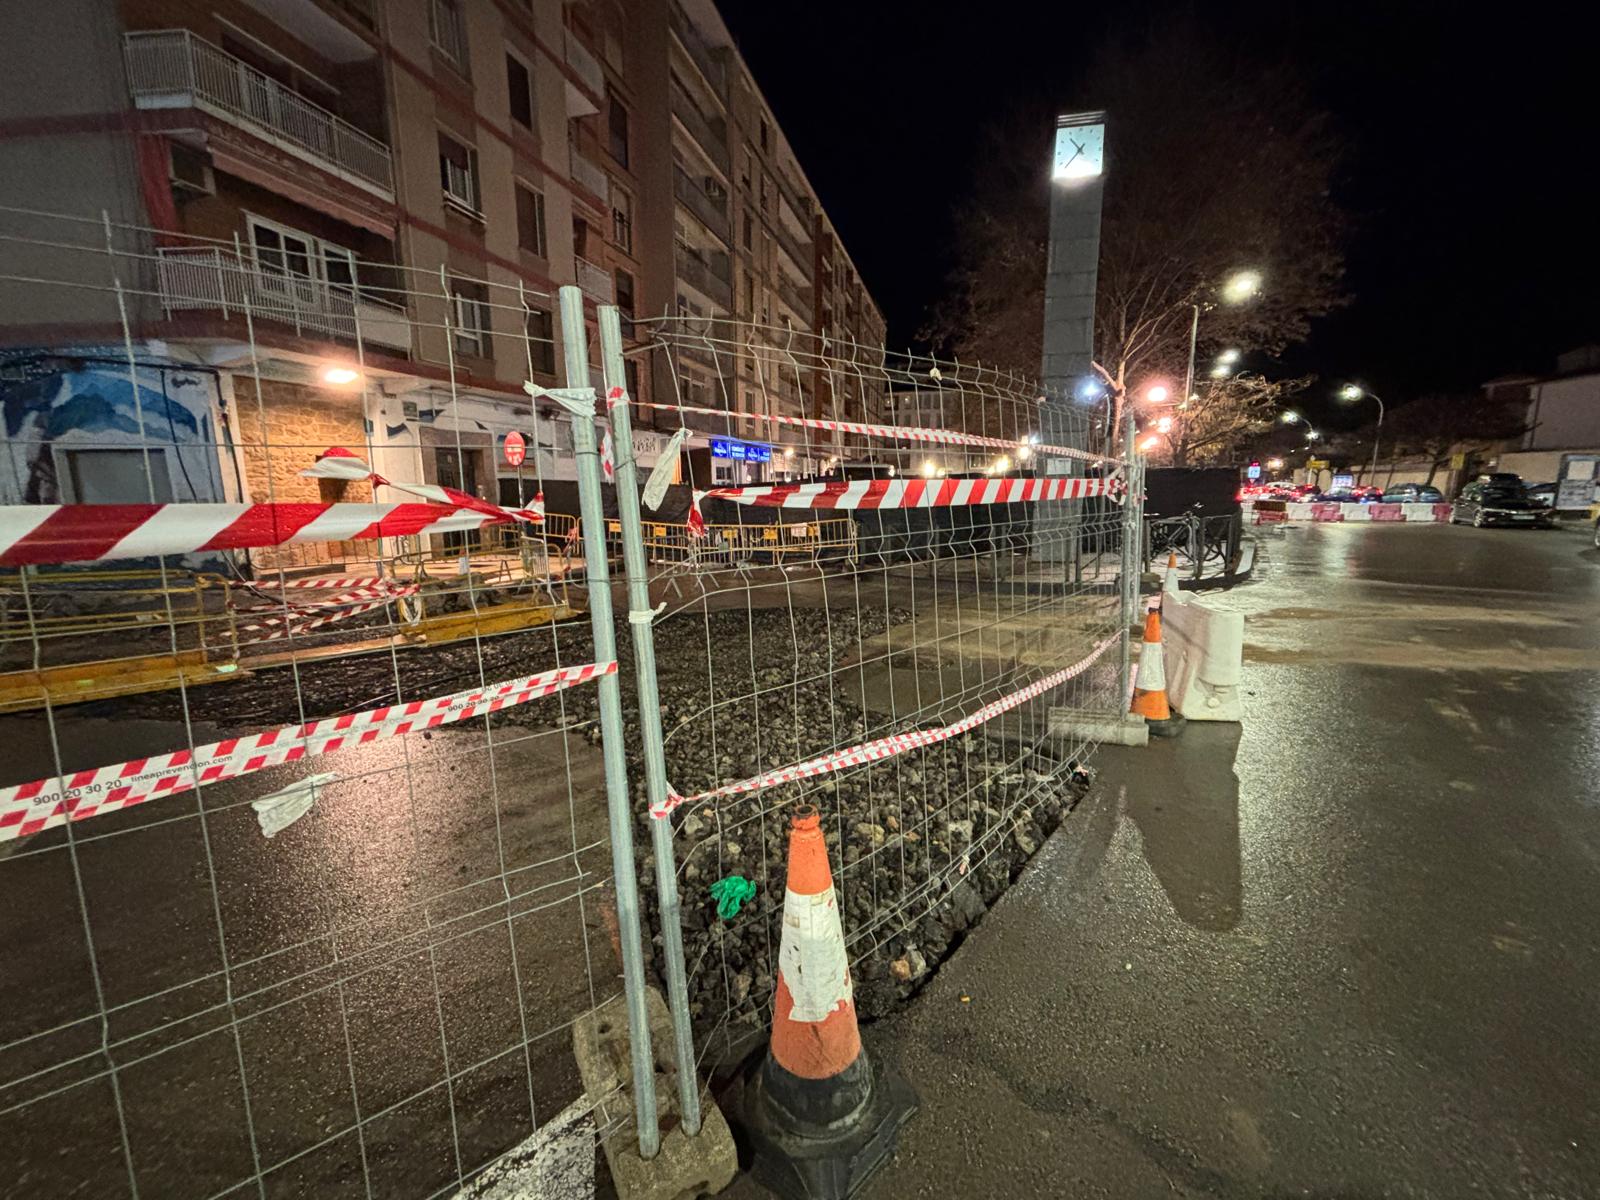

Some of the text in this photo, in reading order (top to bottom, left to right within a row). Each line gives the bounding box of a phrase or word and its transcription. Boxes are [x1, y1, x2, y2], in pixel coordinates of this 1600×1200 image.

[33, 756, 233, 806] 900 20 30 20 lineaprevencon.com
